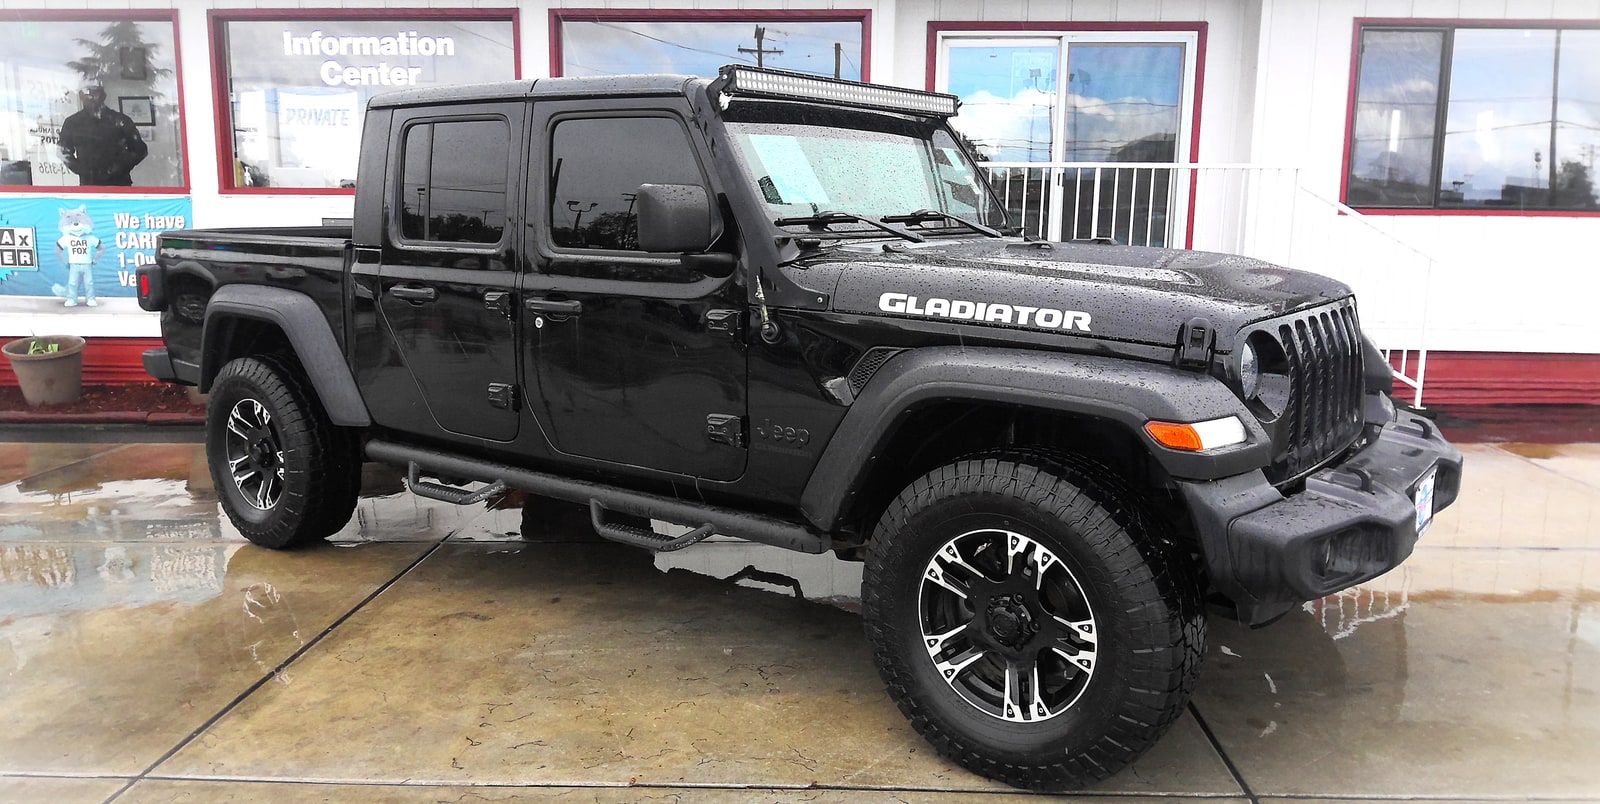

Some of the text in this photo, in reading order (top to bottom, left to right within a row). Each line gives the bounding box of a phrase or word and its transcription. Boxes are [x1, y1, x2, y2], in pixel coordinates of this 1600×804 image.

[283, 31, 455, 56] Information
[320, 60, 422, 86] Center
[286, 108, 350, 126] PRIVATE
[114, 212, 185, 229] We have
[70, 239, 88, 247] CAR
[72, 247, 88, 255] FOX
[878, 292, 1092, 332] GLADIATOR
[756, 418, 811, 449] Jeep
